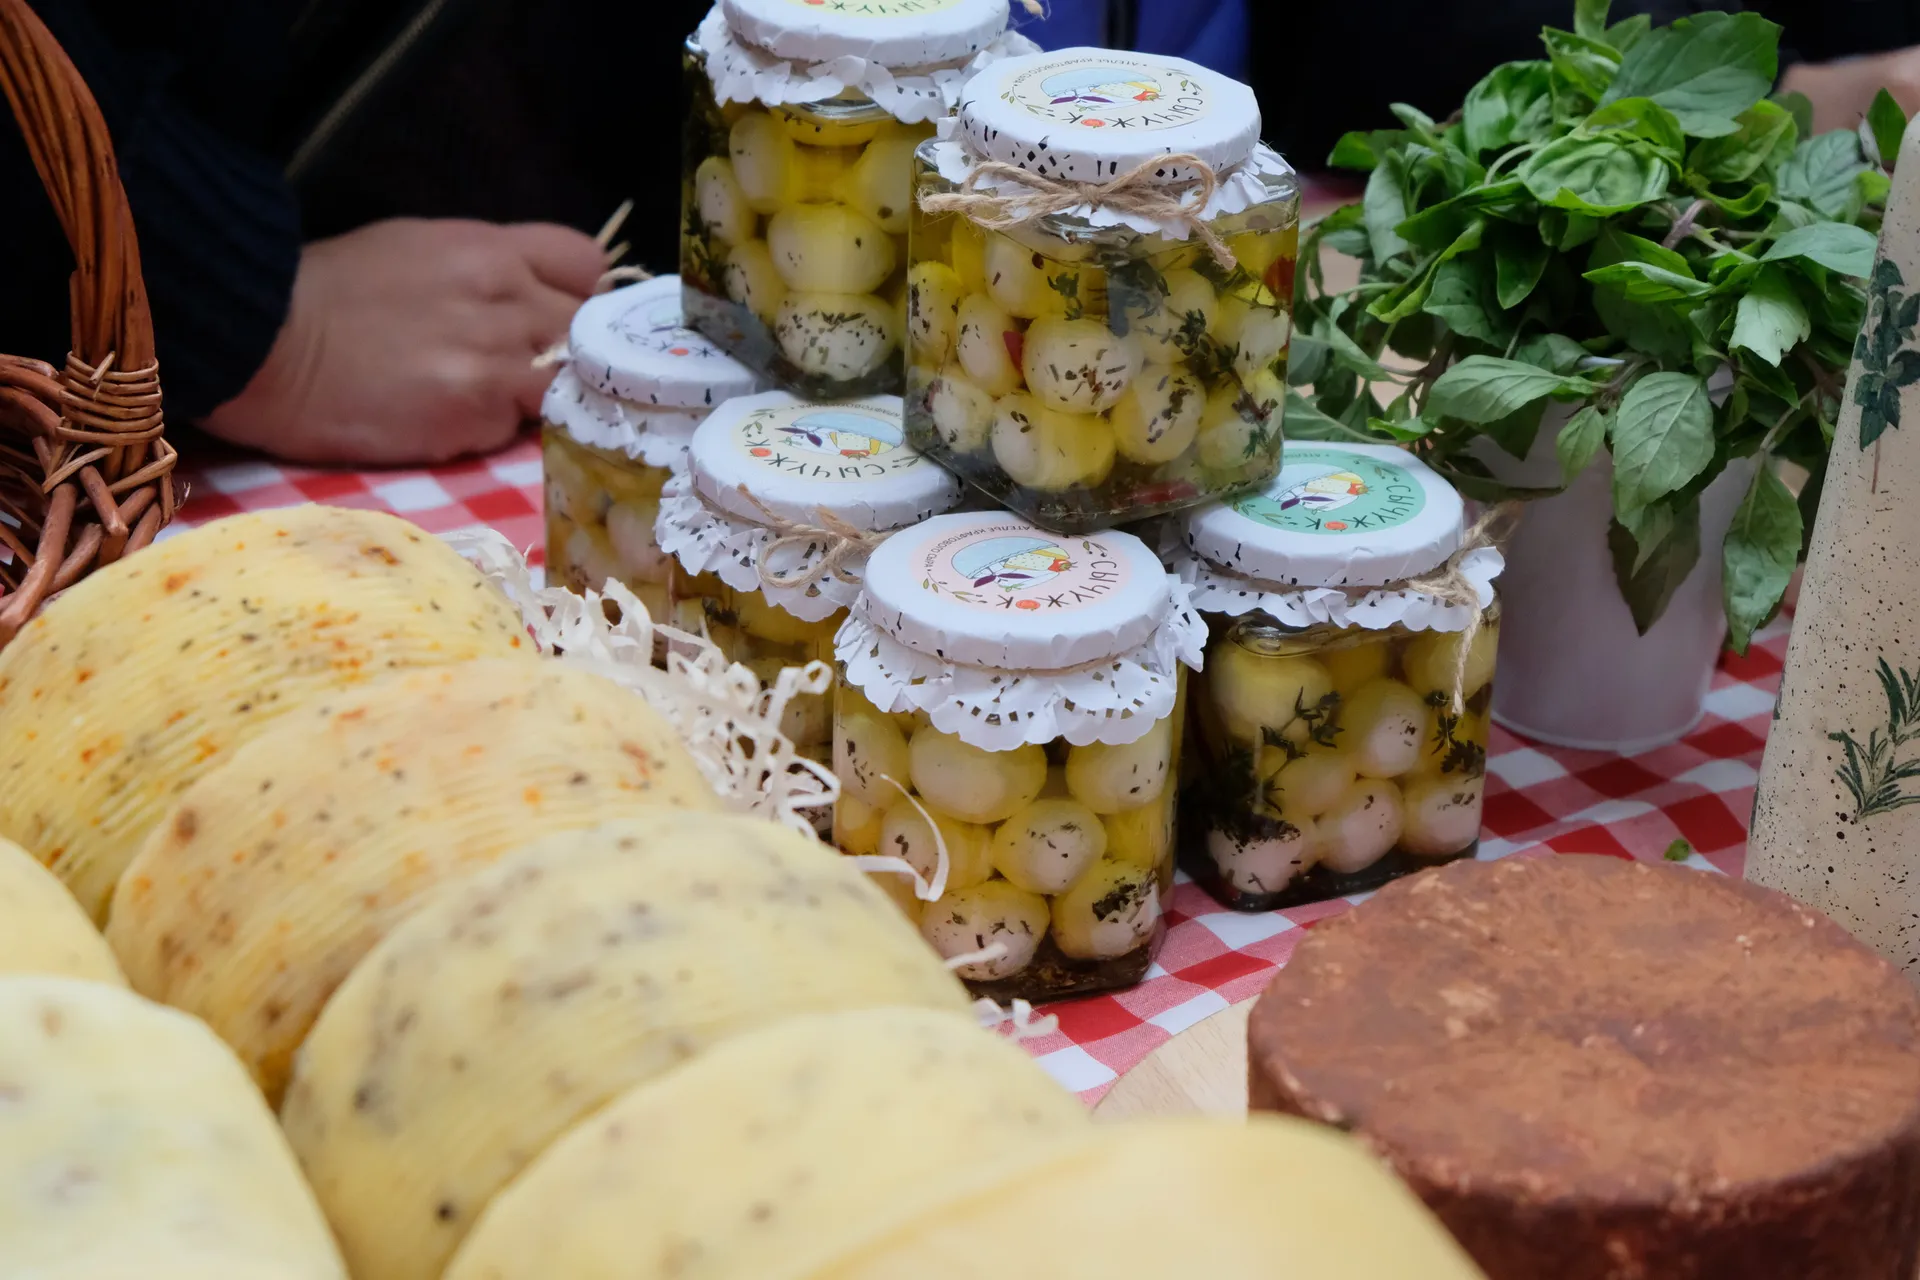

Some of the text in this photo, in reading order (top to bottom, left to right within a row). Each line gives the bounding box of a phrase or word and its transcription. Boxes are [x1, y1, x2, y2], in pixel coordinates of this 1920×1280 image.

[923, 525, 1031, 569] АТЕЛЬЕ КРАФТОВОГО СЫРА
